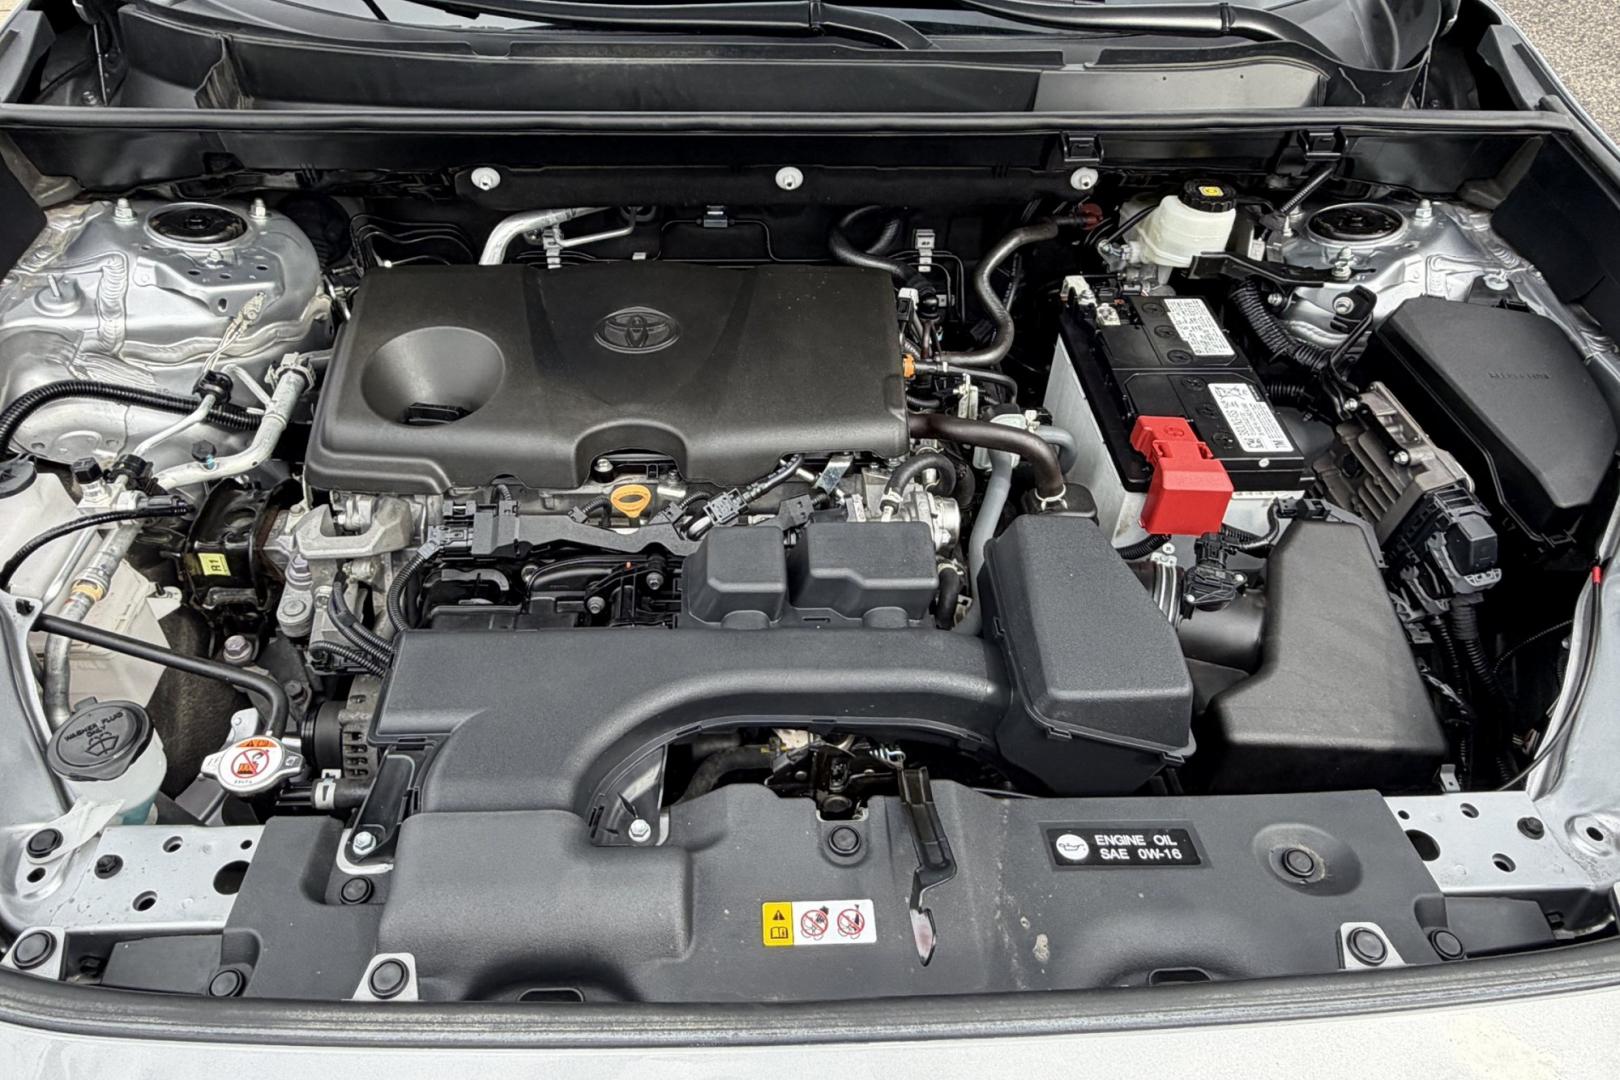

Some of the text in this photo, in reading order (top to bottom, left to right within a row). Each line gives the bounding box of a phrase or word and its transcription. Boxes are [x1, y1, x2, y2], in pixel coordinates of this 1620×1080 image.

[1094, 834, 1178, 846] ENGINE OIL
[1100, 848, 1182, 860] SAE 0W-16
